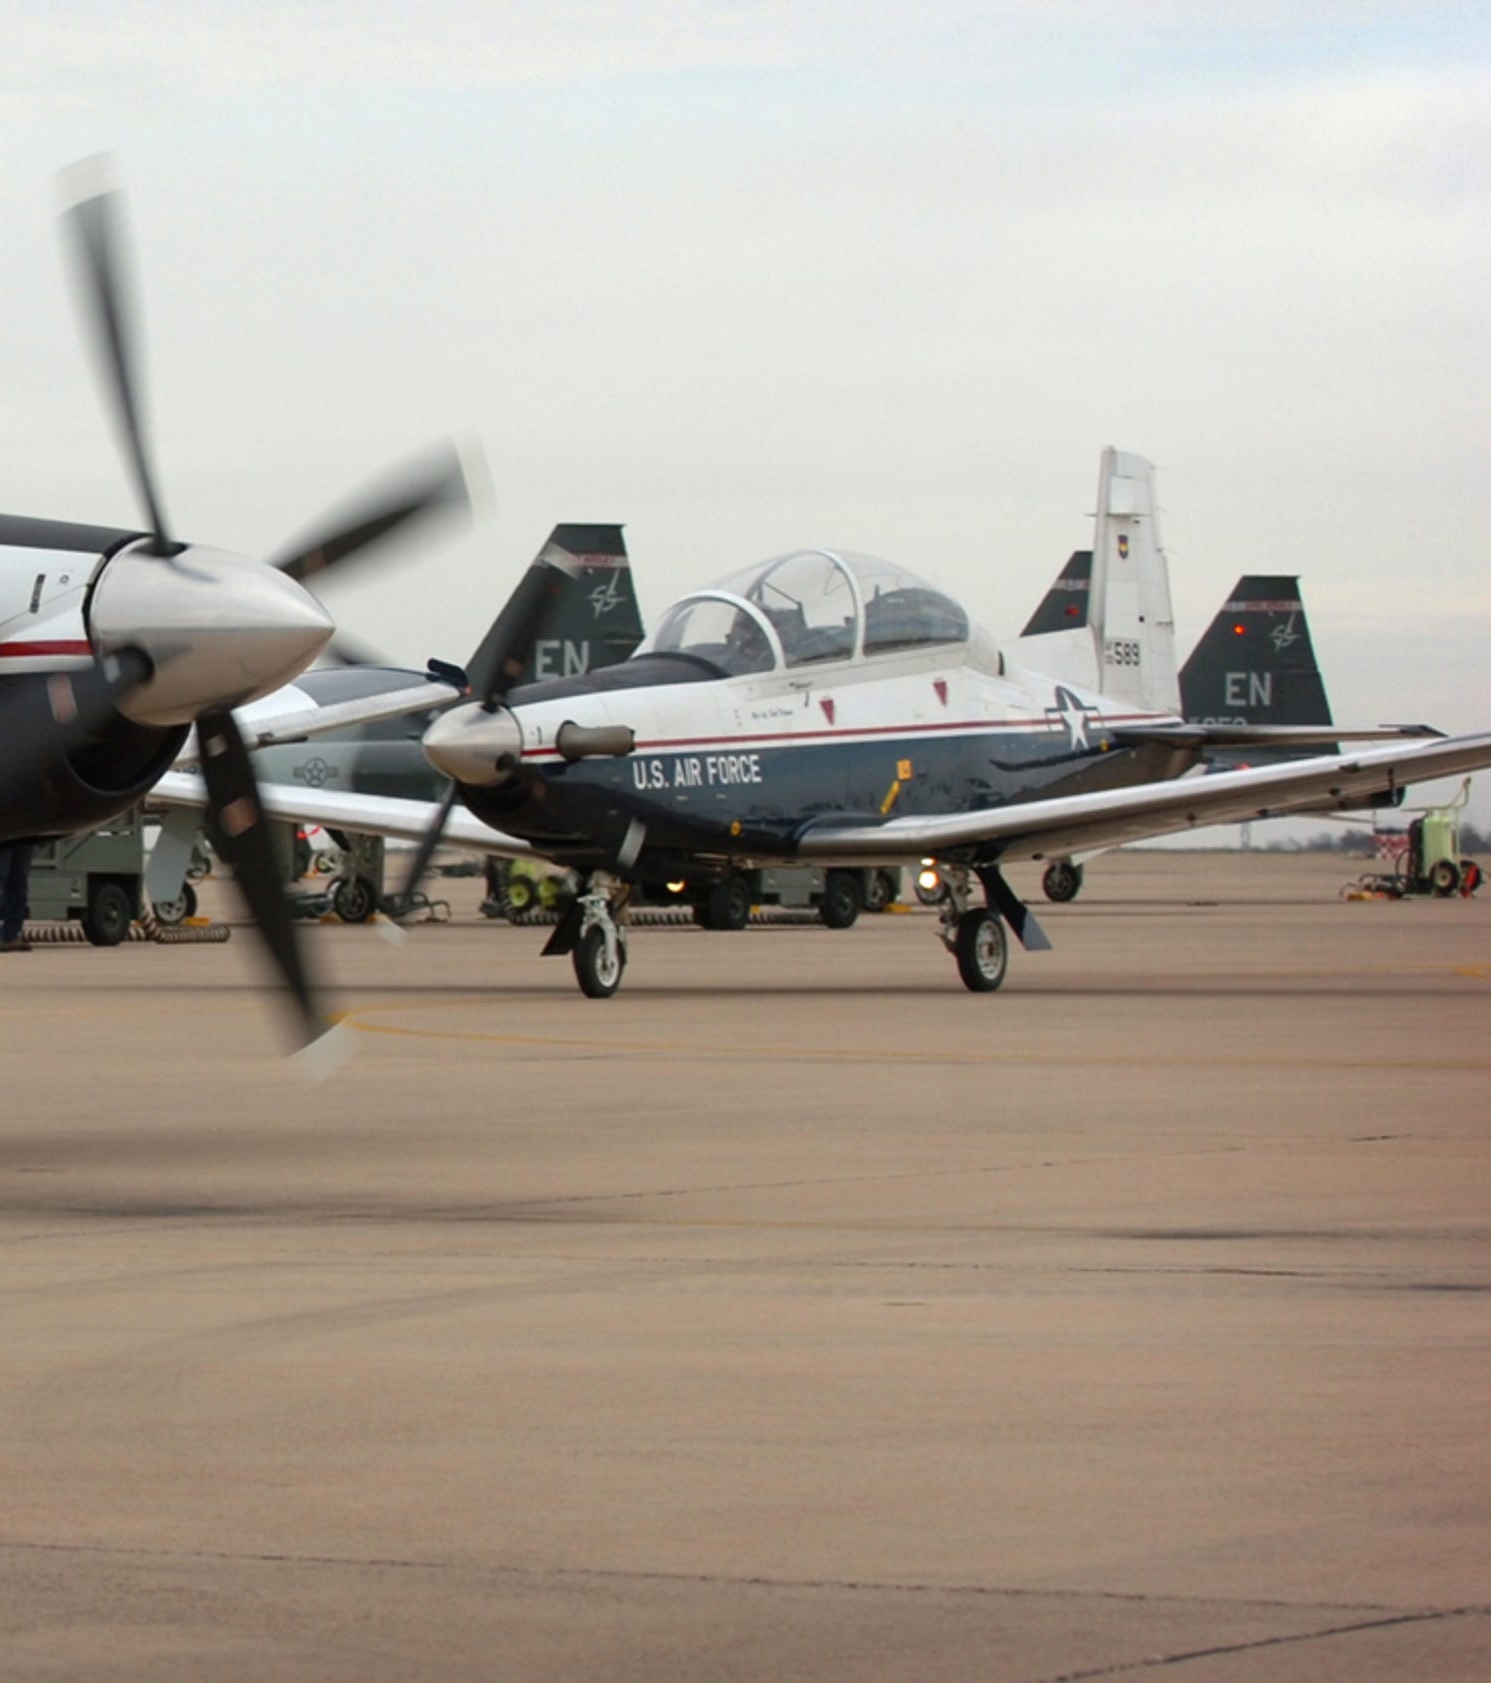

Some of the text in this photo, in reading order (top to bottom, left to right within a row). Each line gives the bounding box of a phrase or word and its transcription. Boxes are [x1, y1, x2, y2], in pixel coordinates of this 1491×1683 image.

[535, 639, 590, 681] EN
[1114, 641, 1140, 667] 589
[1225, 671, 1272, 707] EN
[632, 754, 763, 790] U.S. AIR FORCE
